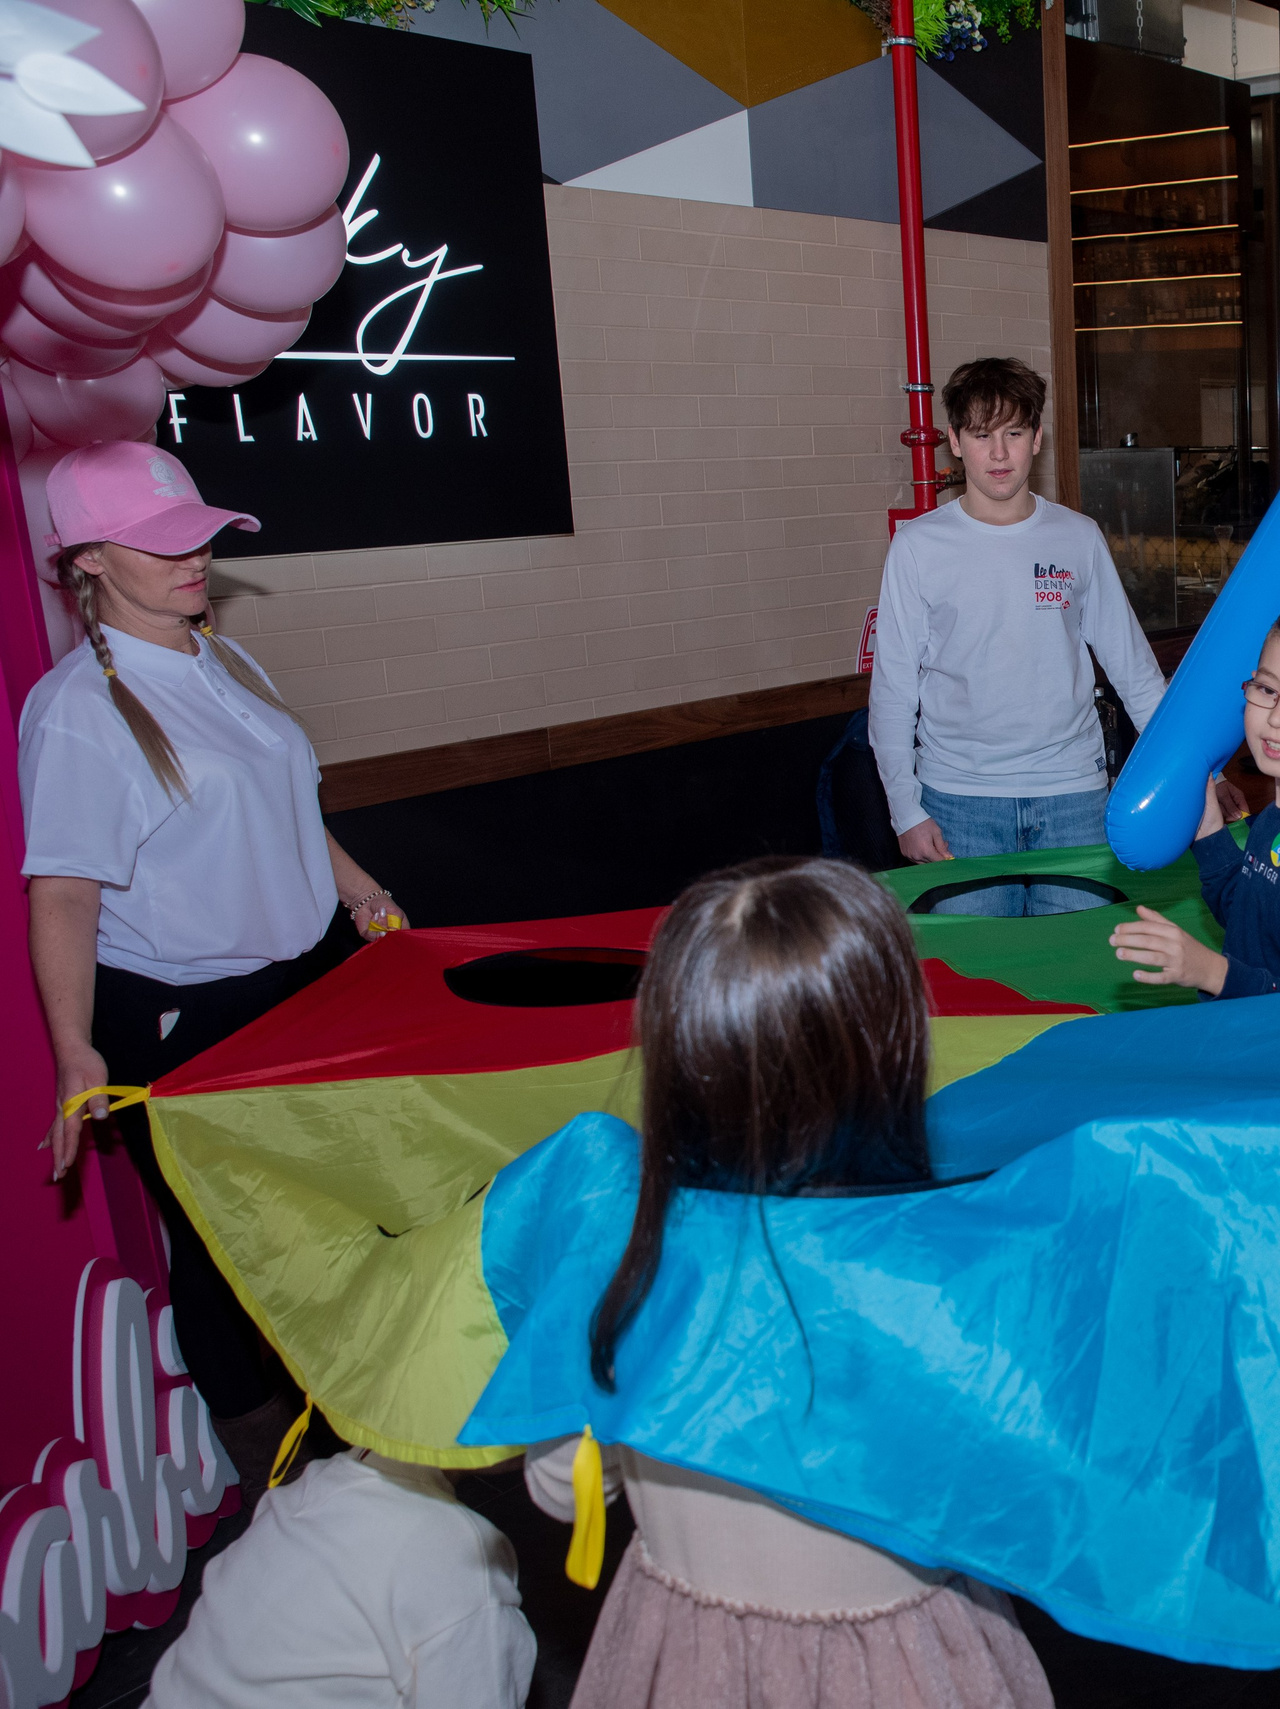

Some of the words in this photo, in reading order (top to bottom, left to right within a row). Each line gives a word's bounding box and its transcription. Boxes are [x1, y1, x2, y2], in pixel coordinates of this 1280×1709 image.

[169, 392, 488, 443] FLAVOR
[1034, 563, 1047, 578] Lee
[1049, 564, 1075, 582] Cooper
[1035, 580, 1073, 591] DENIM
[1035, 592, 1062, 602] 1908
